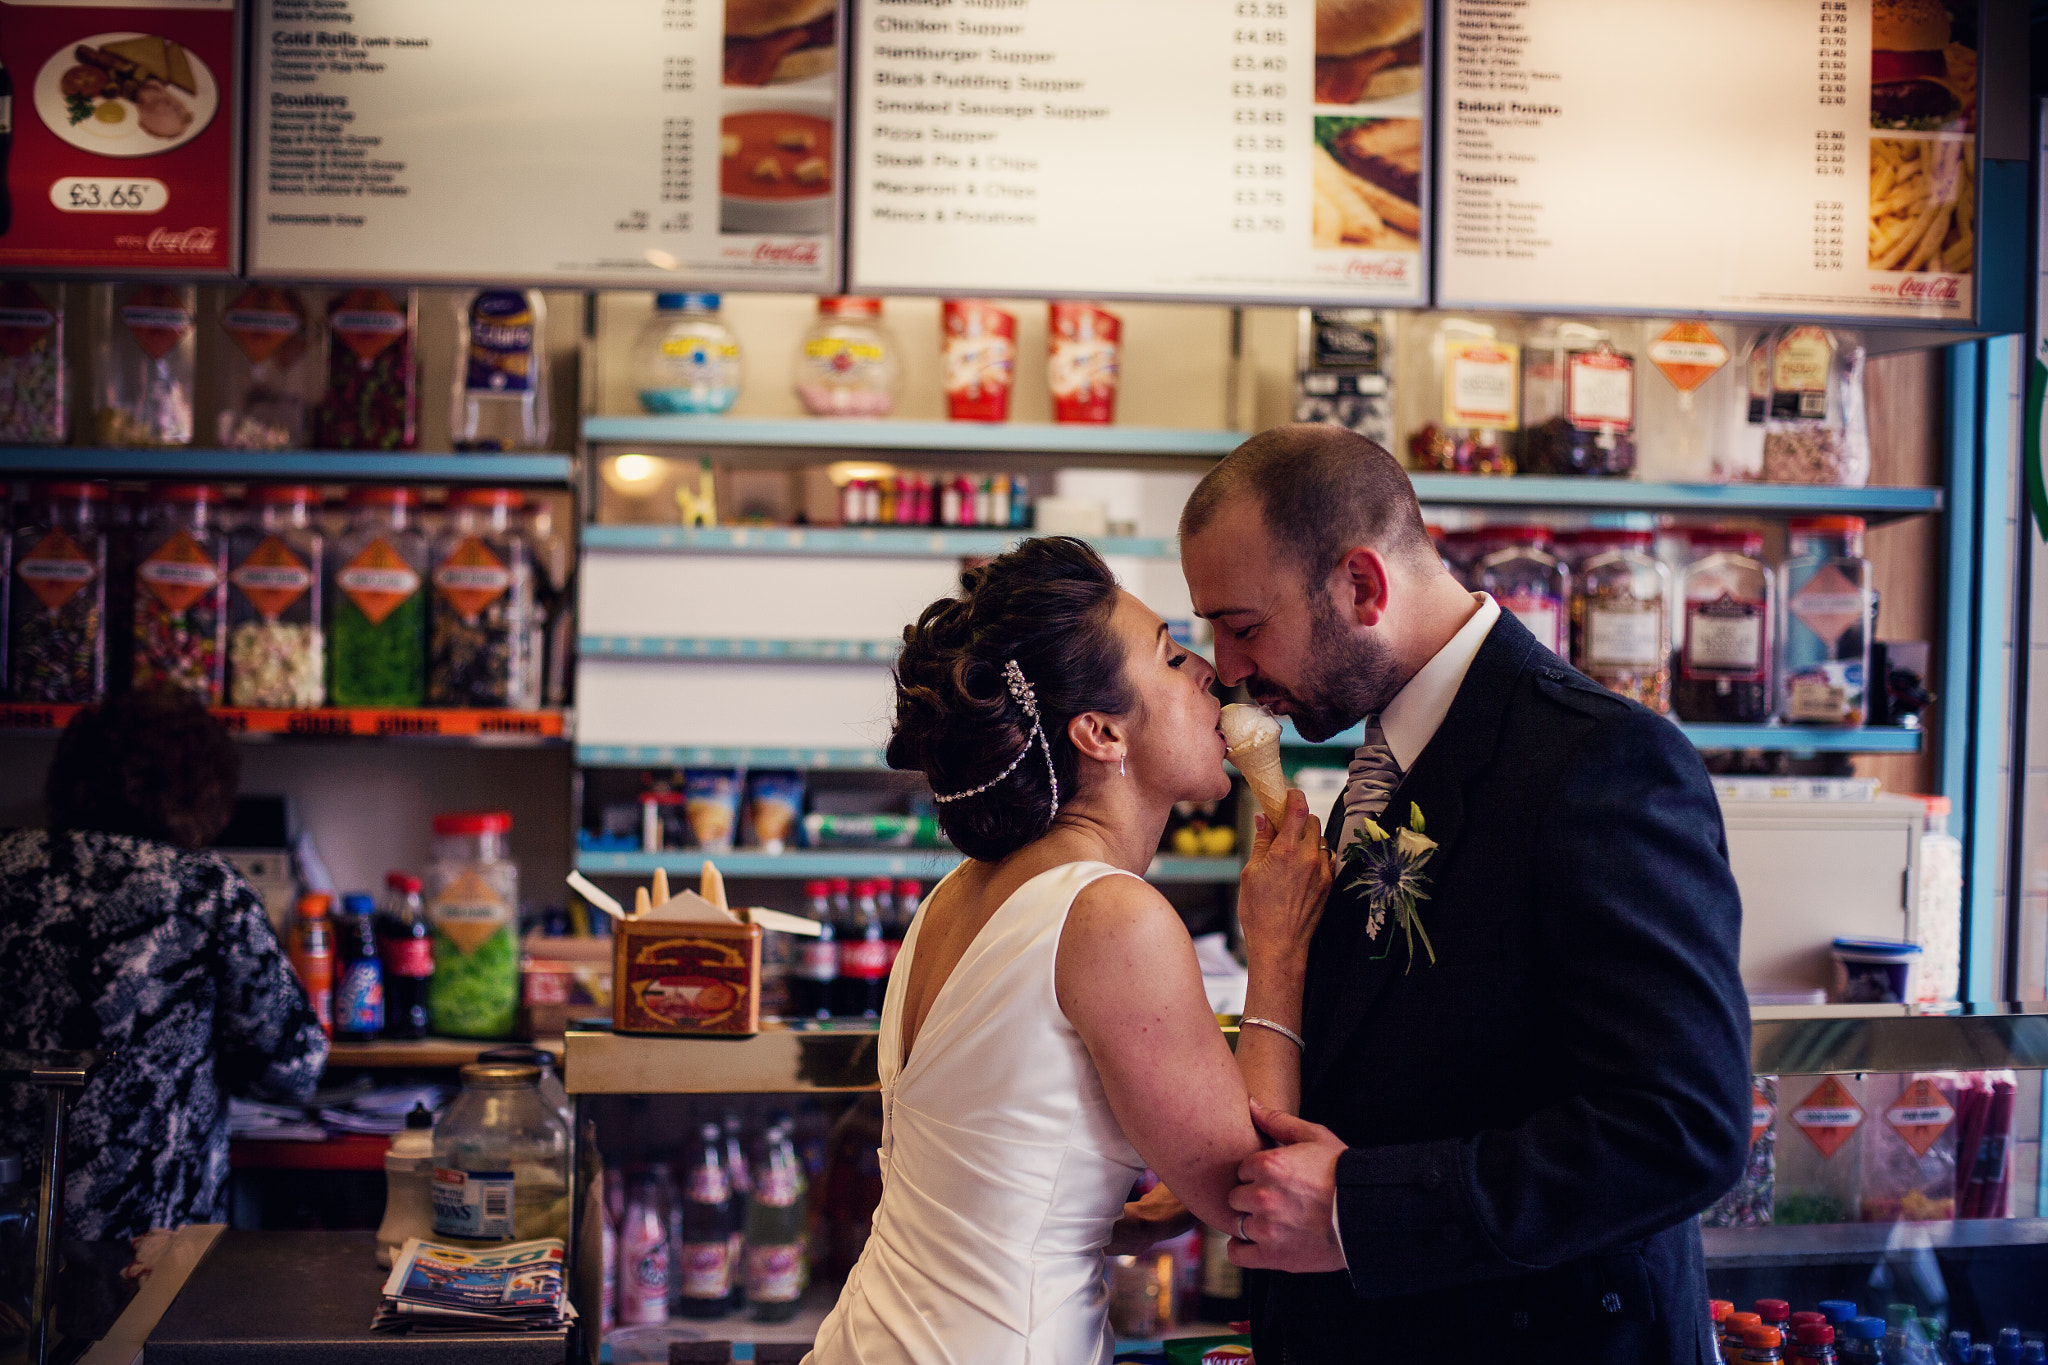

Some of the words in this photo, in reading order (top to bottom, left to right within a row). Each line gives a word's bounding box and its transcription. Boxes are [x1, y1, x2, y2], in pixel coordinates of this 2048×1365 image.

[874, 16, 950, 32] Chicken
[957, 20, 1025, 36] Supper
[874, 46, 982, 63] Hamburger
[988, 49, 1057, 63] Supper
[874, 72, 926, 87] Black
[931, 73, 1012, 91] Pudding
[1017, 77, 1085, 92] Supper
[874, 100, 952, 115] Smoked
[956, 101, 1036, 118] Sausage
[1042, 104, 1110, 119] Supper
[874, 126, 924, 141] Pizza
[930, 128, 998, 143] Supper
[874, 154, 925, 168] Steak
[931, 155, 960, 168] Pie
[985, 156, 1039, 172] Chips
[984, 183, 1038, 199] Chips
[873, 207, 927, 222] Mince
[147, 227, 218, 253] Coca-Cola
[1898, 276, 1963, 300] Coca-Cola
